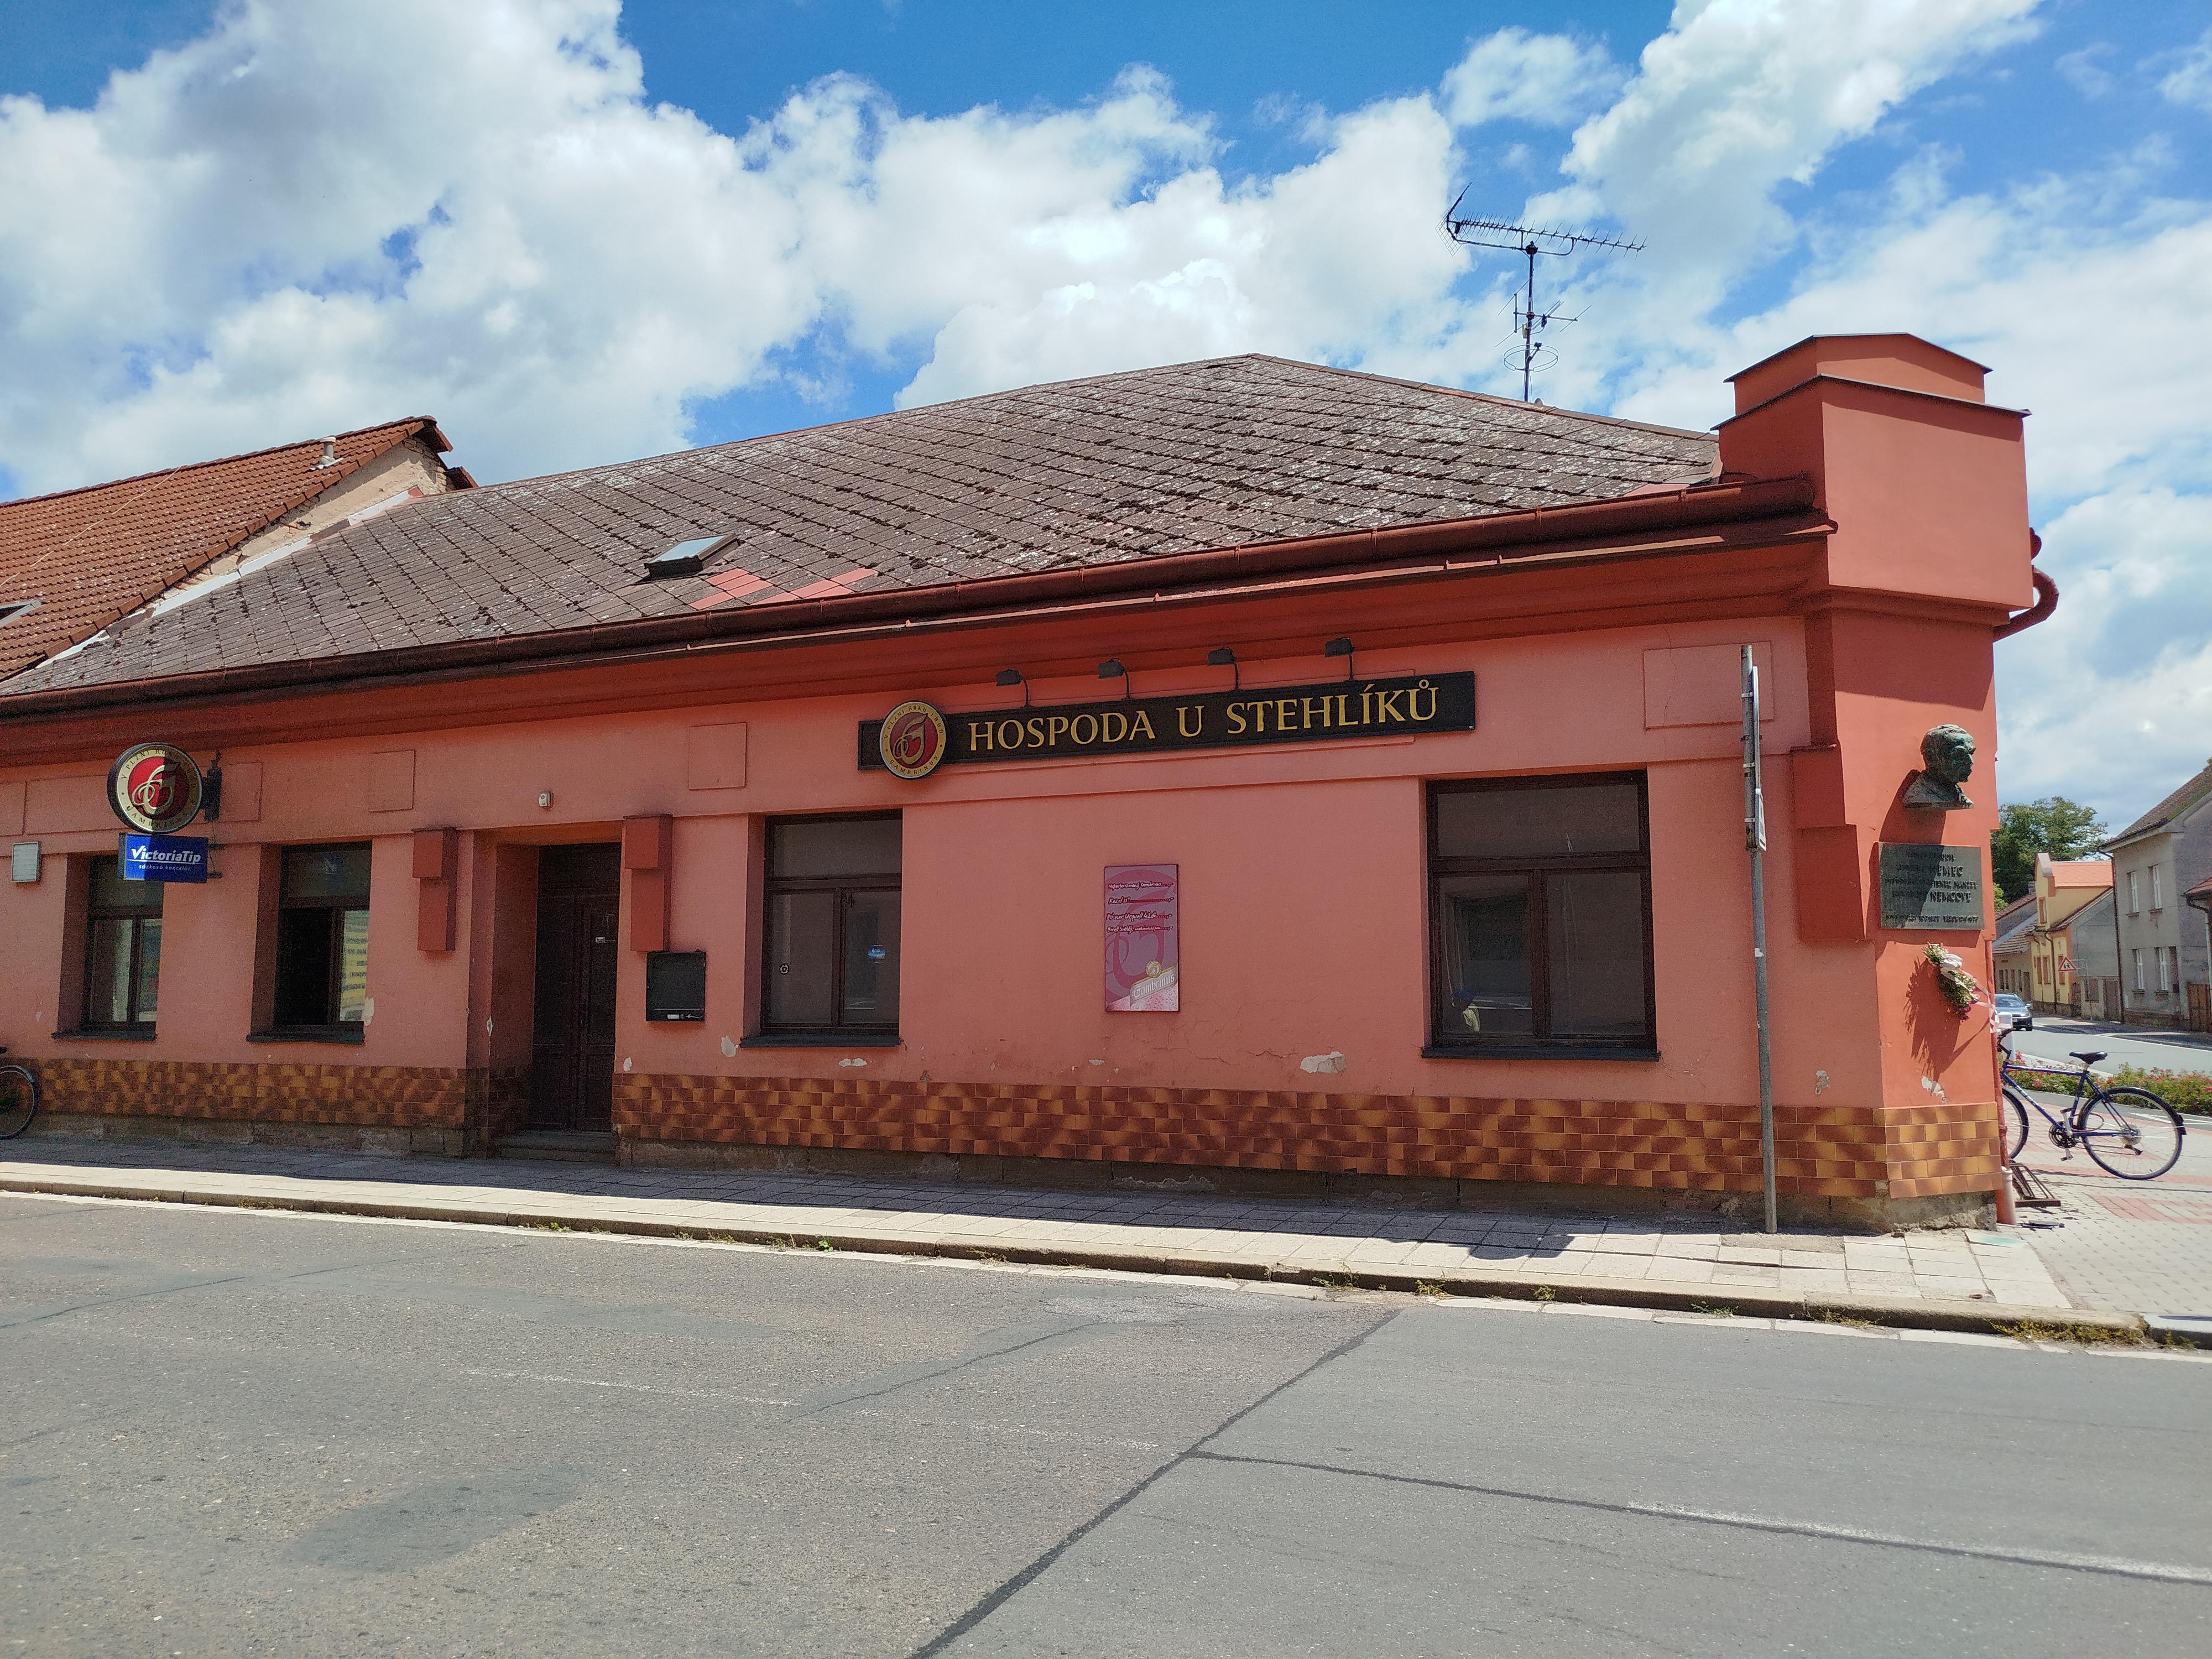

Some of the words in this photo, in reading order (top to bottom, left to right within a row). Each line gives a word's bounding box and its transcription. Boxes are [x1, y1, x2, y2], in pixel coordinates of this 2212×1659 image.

[968, 710, 1156, 751] HOSPODA
[1176, 705, 1205, 737] U
[1226, 679, 1439, 734] STEHLÍKŮ
[131, 844, 202, 864] VictoriaTip
[1132, 974, 1175, 998] Gambrinus
